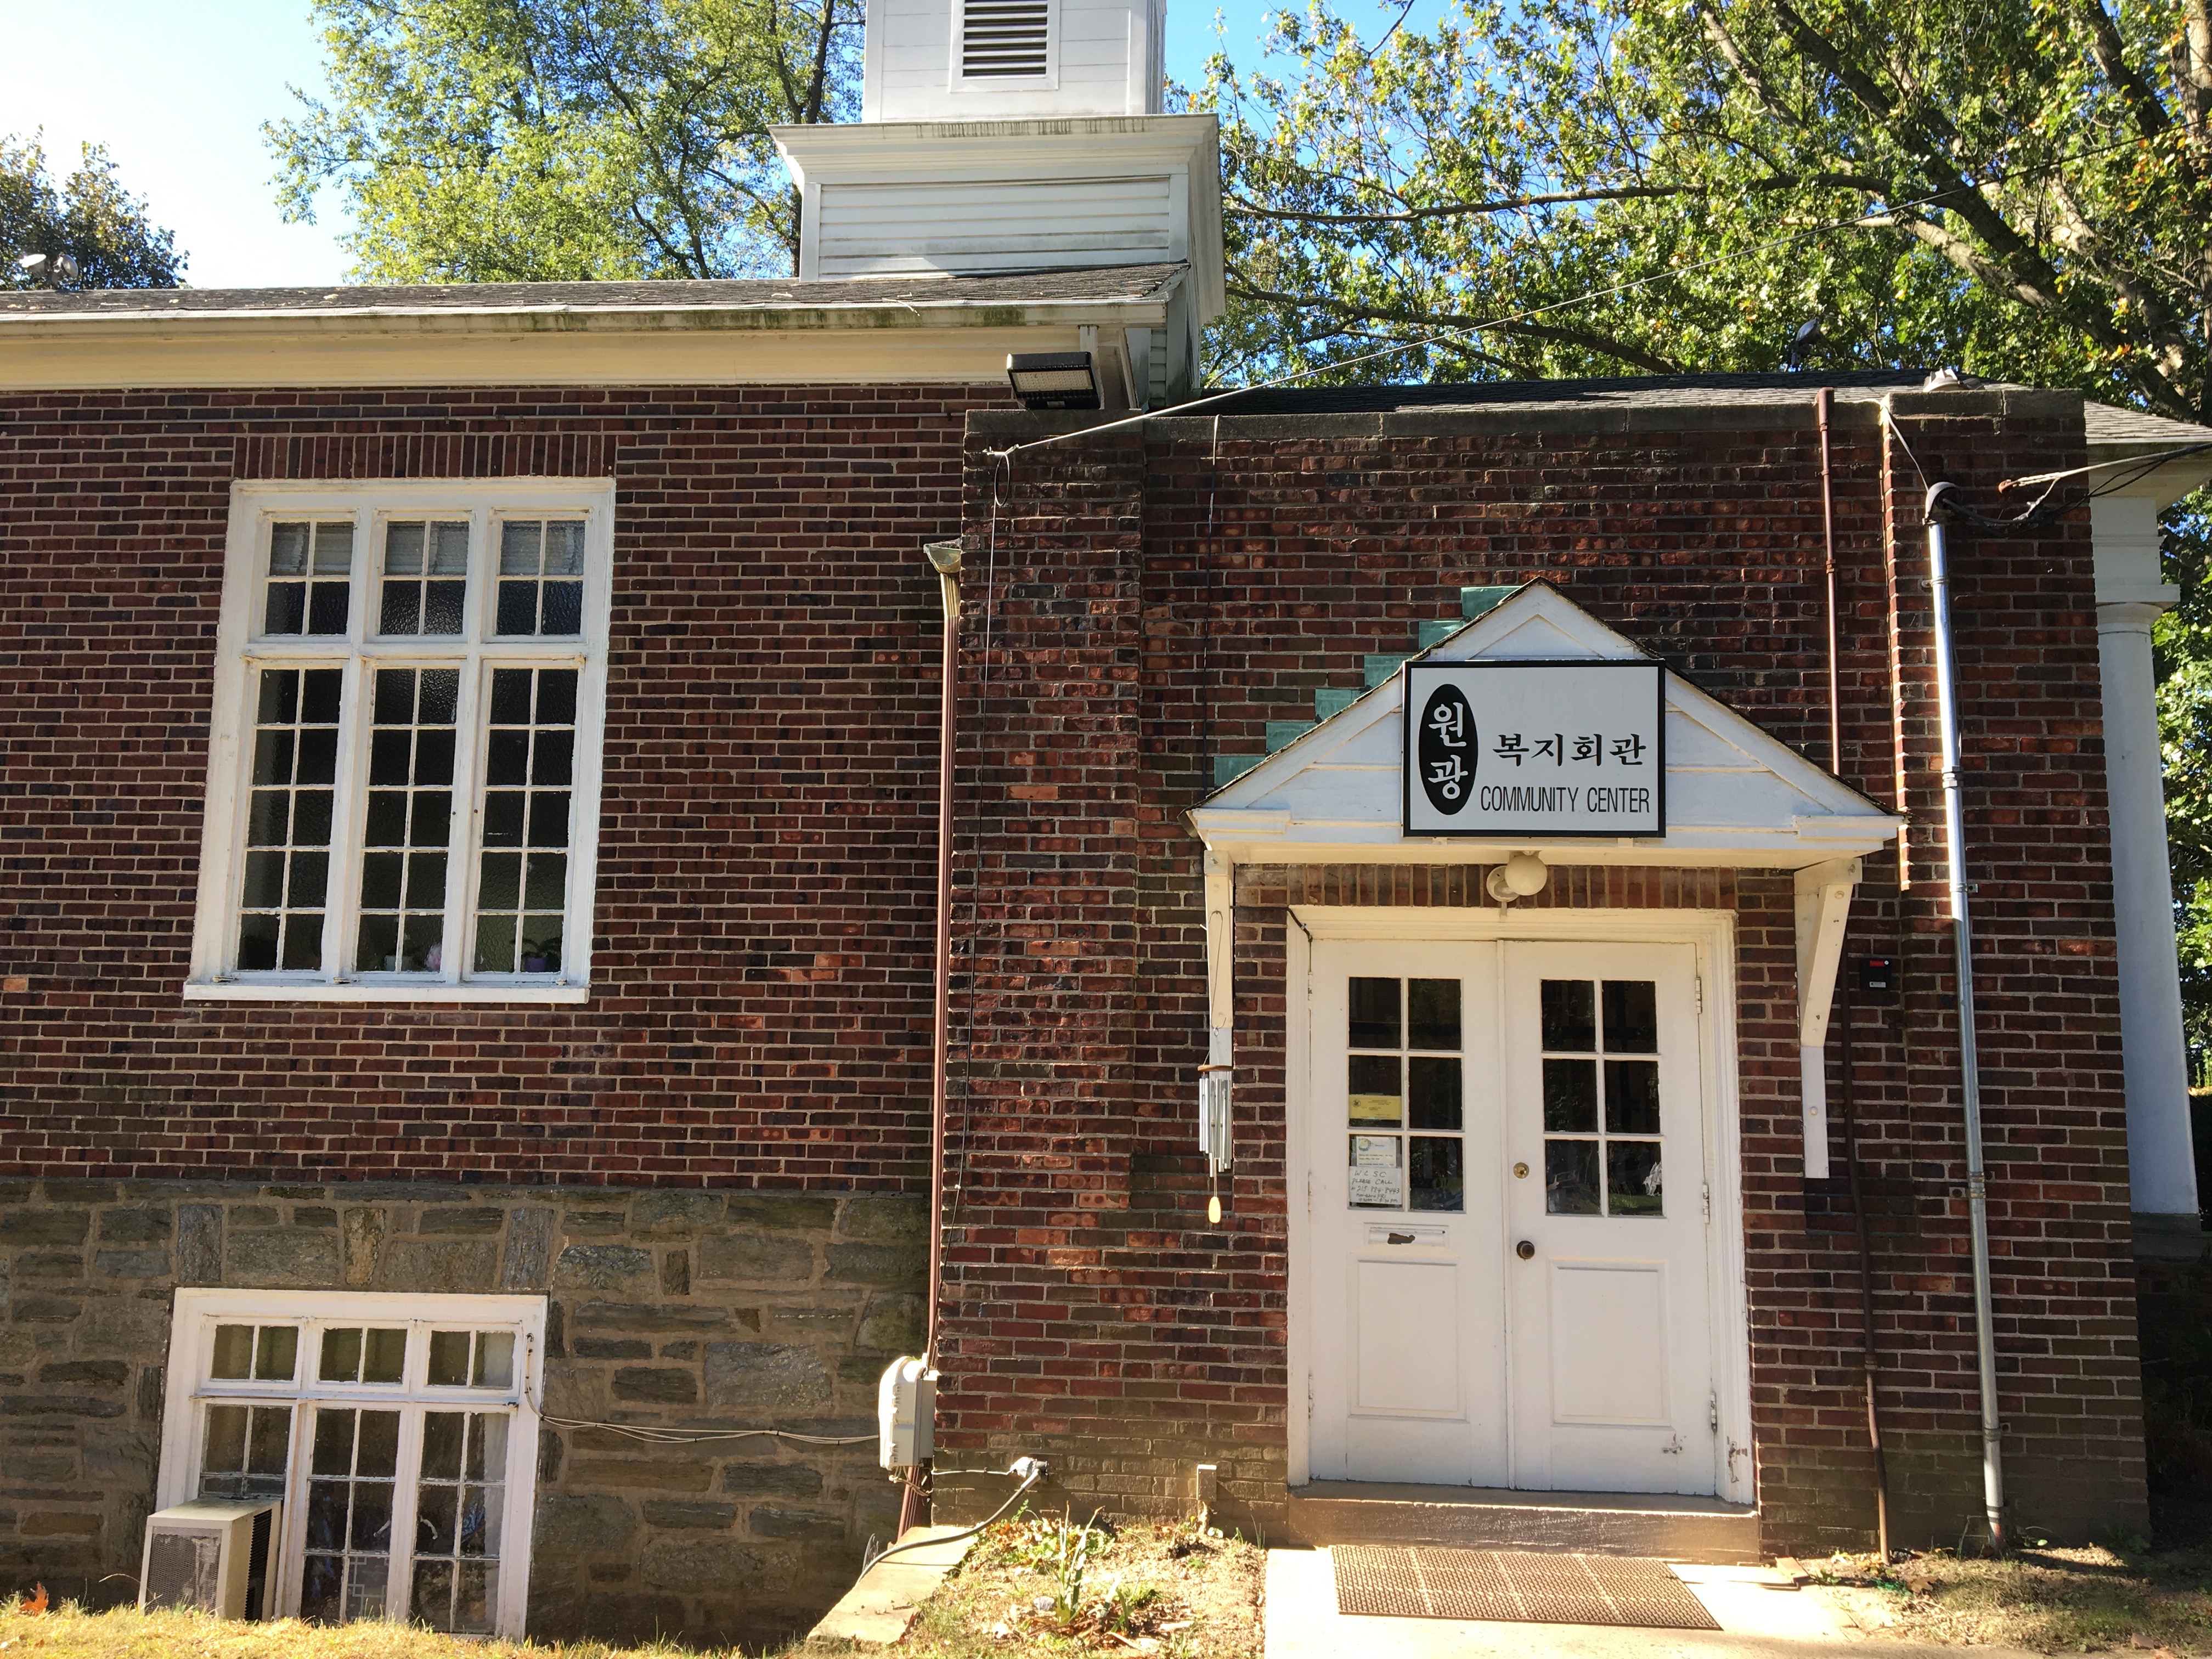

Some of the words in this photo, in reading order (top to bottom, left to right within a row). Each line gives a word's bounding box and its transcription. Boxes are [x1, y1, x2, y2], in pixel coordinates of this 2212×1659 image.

[1428, 702, 1468, 799] 원광
[1492, 733, 1646, 766] 복지회관
[1481, 786, 1579, 812] COMMUNITY
[1587, 787, 1650, 813] CENTER
